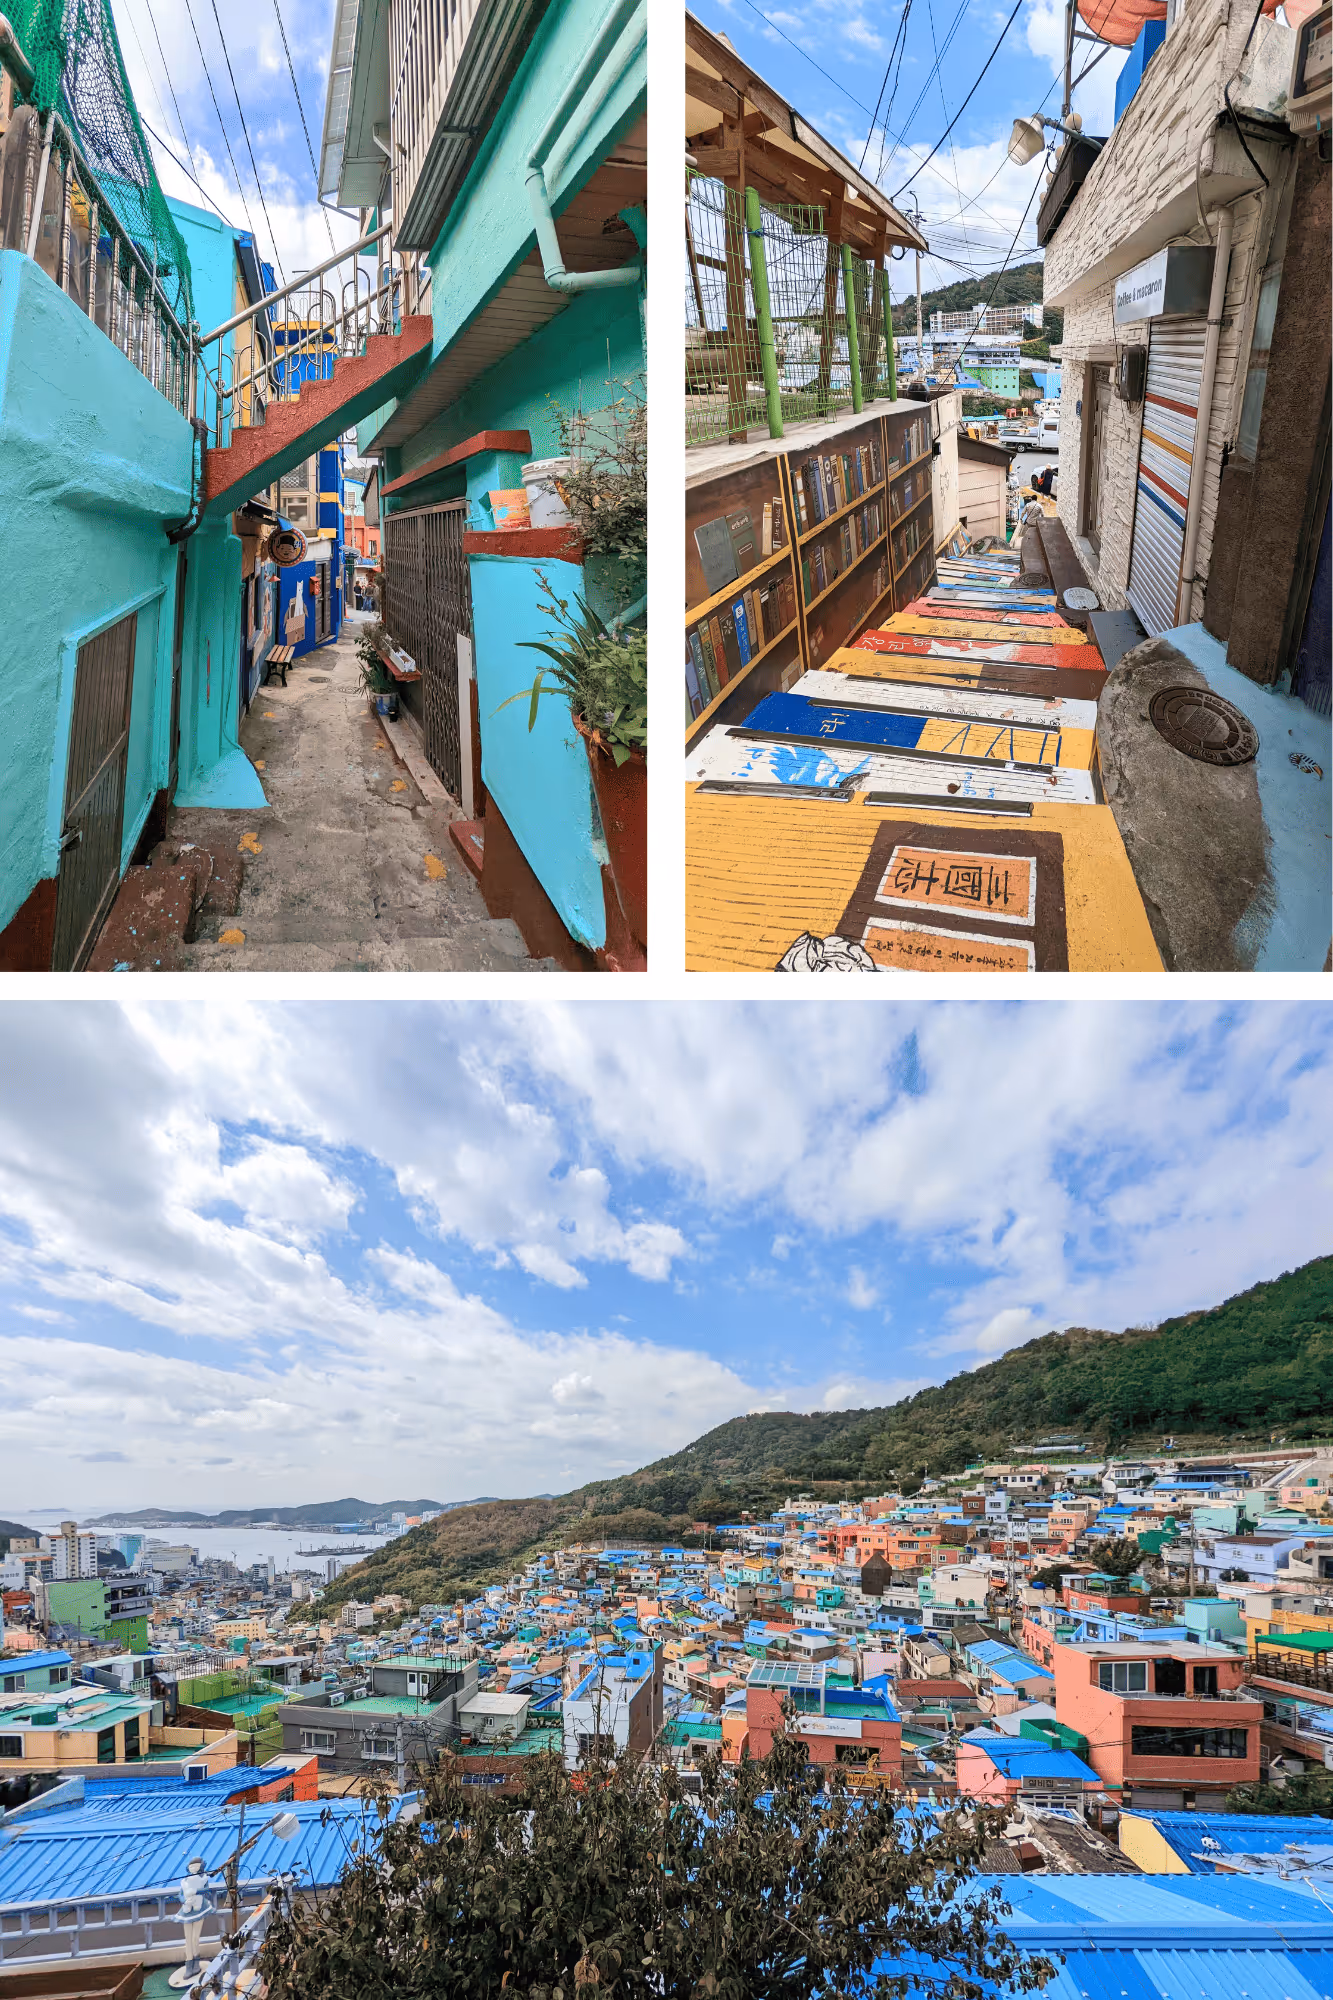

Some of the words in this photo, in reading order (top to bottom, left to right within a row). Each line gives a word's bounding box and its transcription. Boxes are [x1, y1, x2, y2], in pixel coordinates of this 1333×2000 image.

[1117, 291, 1132, 308] Coffee
[1136, 278, 1163, 300] macaron
[894, 858, 1009, 906] 三國志
